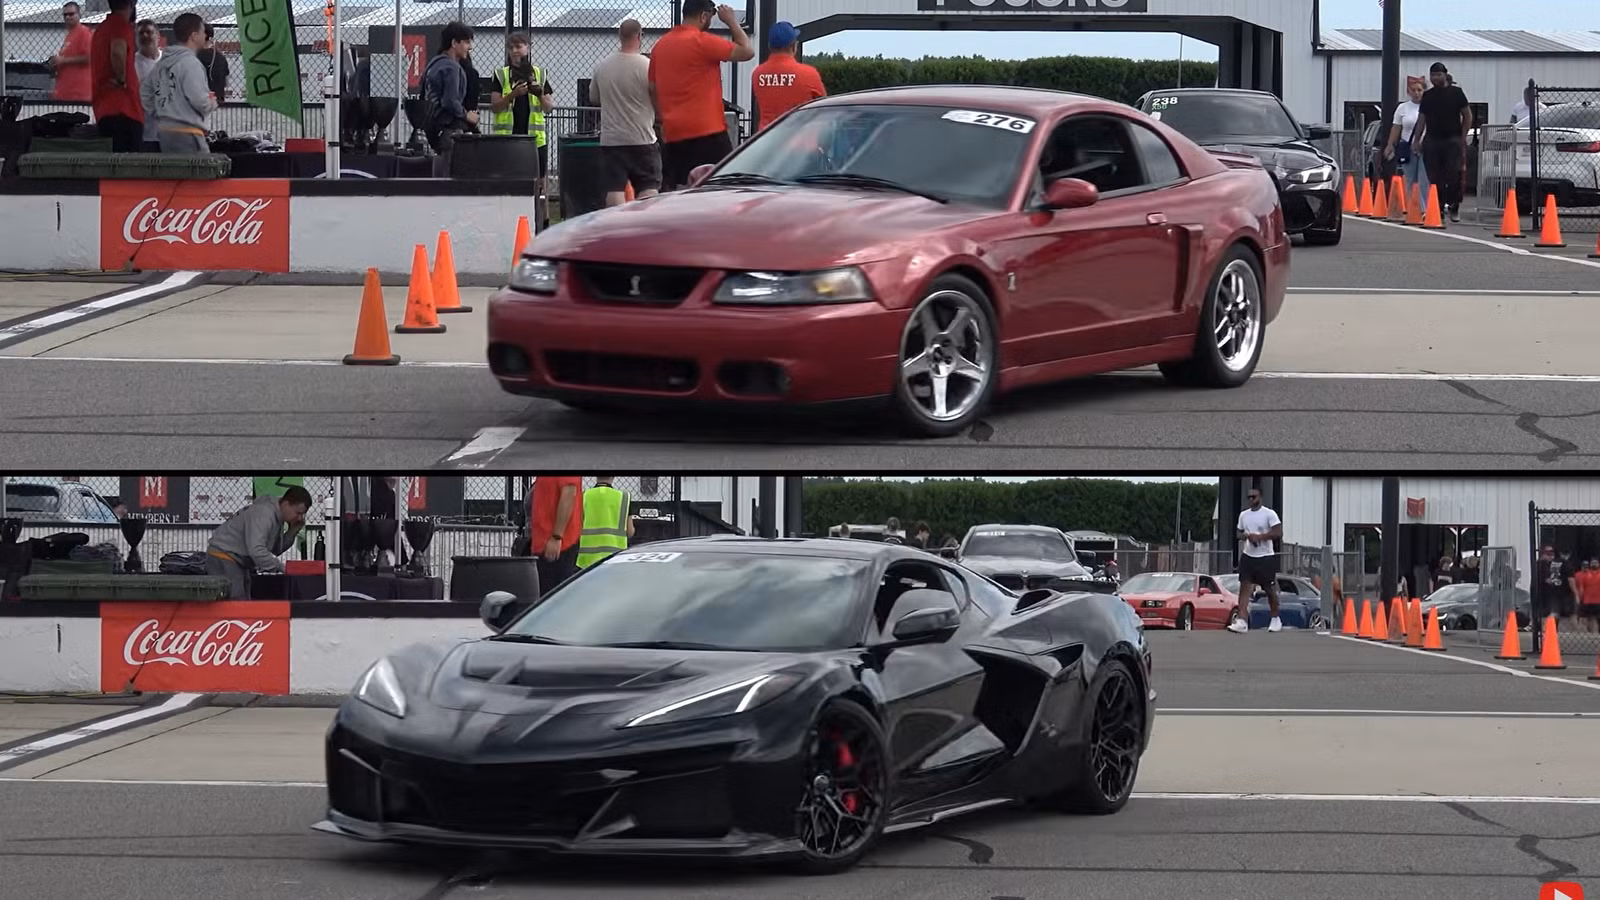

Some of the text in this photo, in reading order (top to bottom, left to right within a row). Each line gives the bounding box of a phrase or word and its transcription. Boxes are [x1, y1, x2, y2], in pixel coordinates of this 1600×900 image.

[240, 0, 285, 97] RACE
[759, 74, 796, 86] STAFF
[1152, 97, 1178, 105] 238
[974, 114, 1027, 130] 276
[123, 198, 272, 244] Coca-Cola
[124, 619, 272, 666] Coca-Cola
